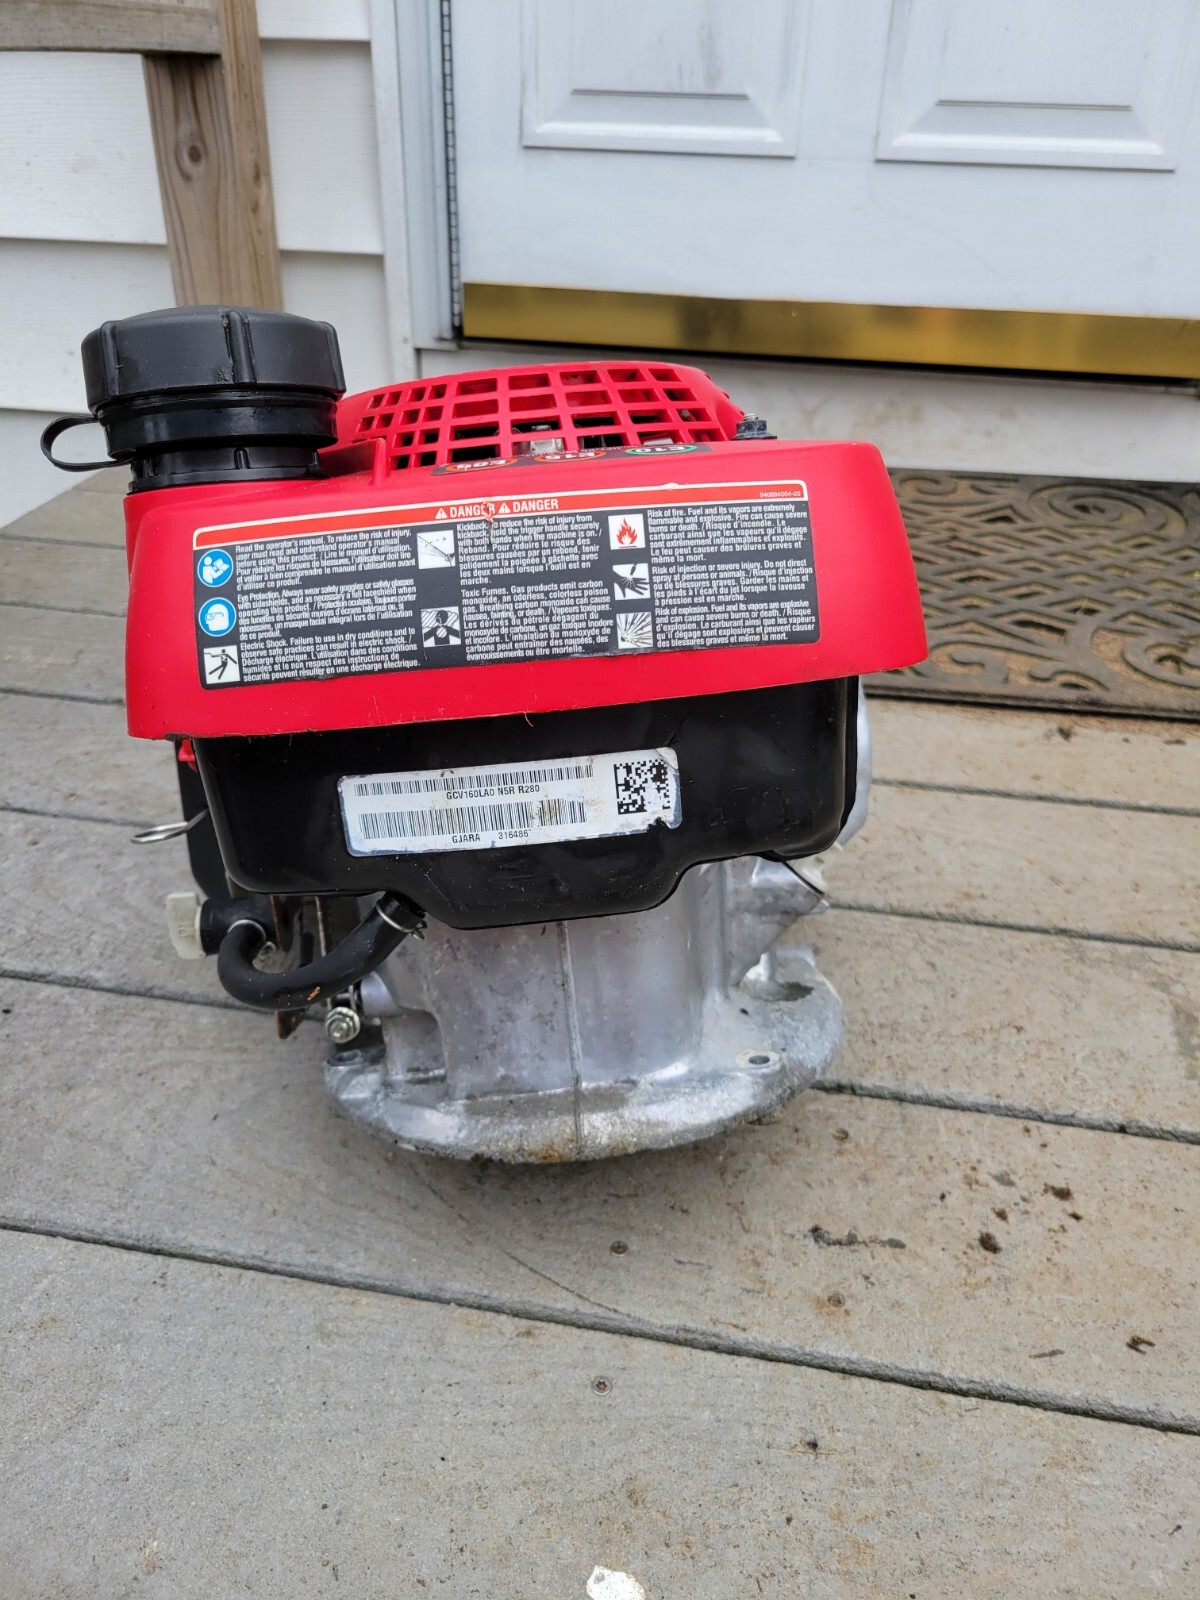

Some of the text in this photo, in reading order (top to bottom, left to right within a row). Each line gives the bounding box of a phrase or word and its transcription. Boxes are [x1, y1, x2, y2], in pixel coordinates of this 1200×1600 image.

[512, 498, 559, 512] DANGER
[647, 509, 663, 517] Risk
[664, 509, 671, 517] of
[704, 507, 718, 515] and
[728, 507, 751, 515] vapors
[685, 515, 698, 523] and
[735, 513, 749, 521] Fire
[687, 530, 706, 538] ainsi
[707, 531, 721, 539] que
[723, 529, 734, 537] les
[736, 529, 765, 538] vapeurs
[661, 547, 673, 555] feu
[674, 546, 691, 556] peut
[768, 543, 793, 551] graves
[794, 541, 802, 549] et
[652, 566, 668, 574] Risk
[764, 561, 774, 569] Do
[775, 560, 786, 568] not
[787, 559, 807, 567] direct
[654, 590, 665, 598] les
[666, 589, 687, 598] pieds
[730, 586, 740, 595] jet
[741, 585, 768, 595] lorsque
[769, 584, 777, 592] la
[778, 583, 805, 591] laveuse
[661, 597, 692, 607] pression
[694, 596, 705, 604] est
[700, 621, 710, 629] Le
[763, 619, 776, 627] que
[777, 617, 788, 625] les
[789, 617, 816, 626] vapeurs
[657, 639, 670, 647] des
[706, 637, 729, 646] graves
[497, 786, 515, 795] N5R
[518, 784, 540, 794] R280
[451, 833, 481, 843] GJARA
